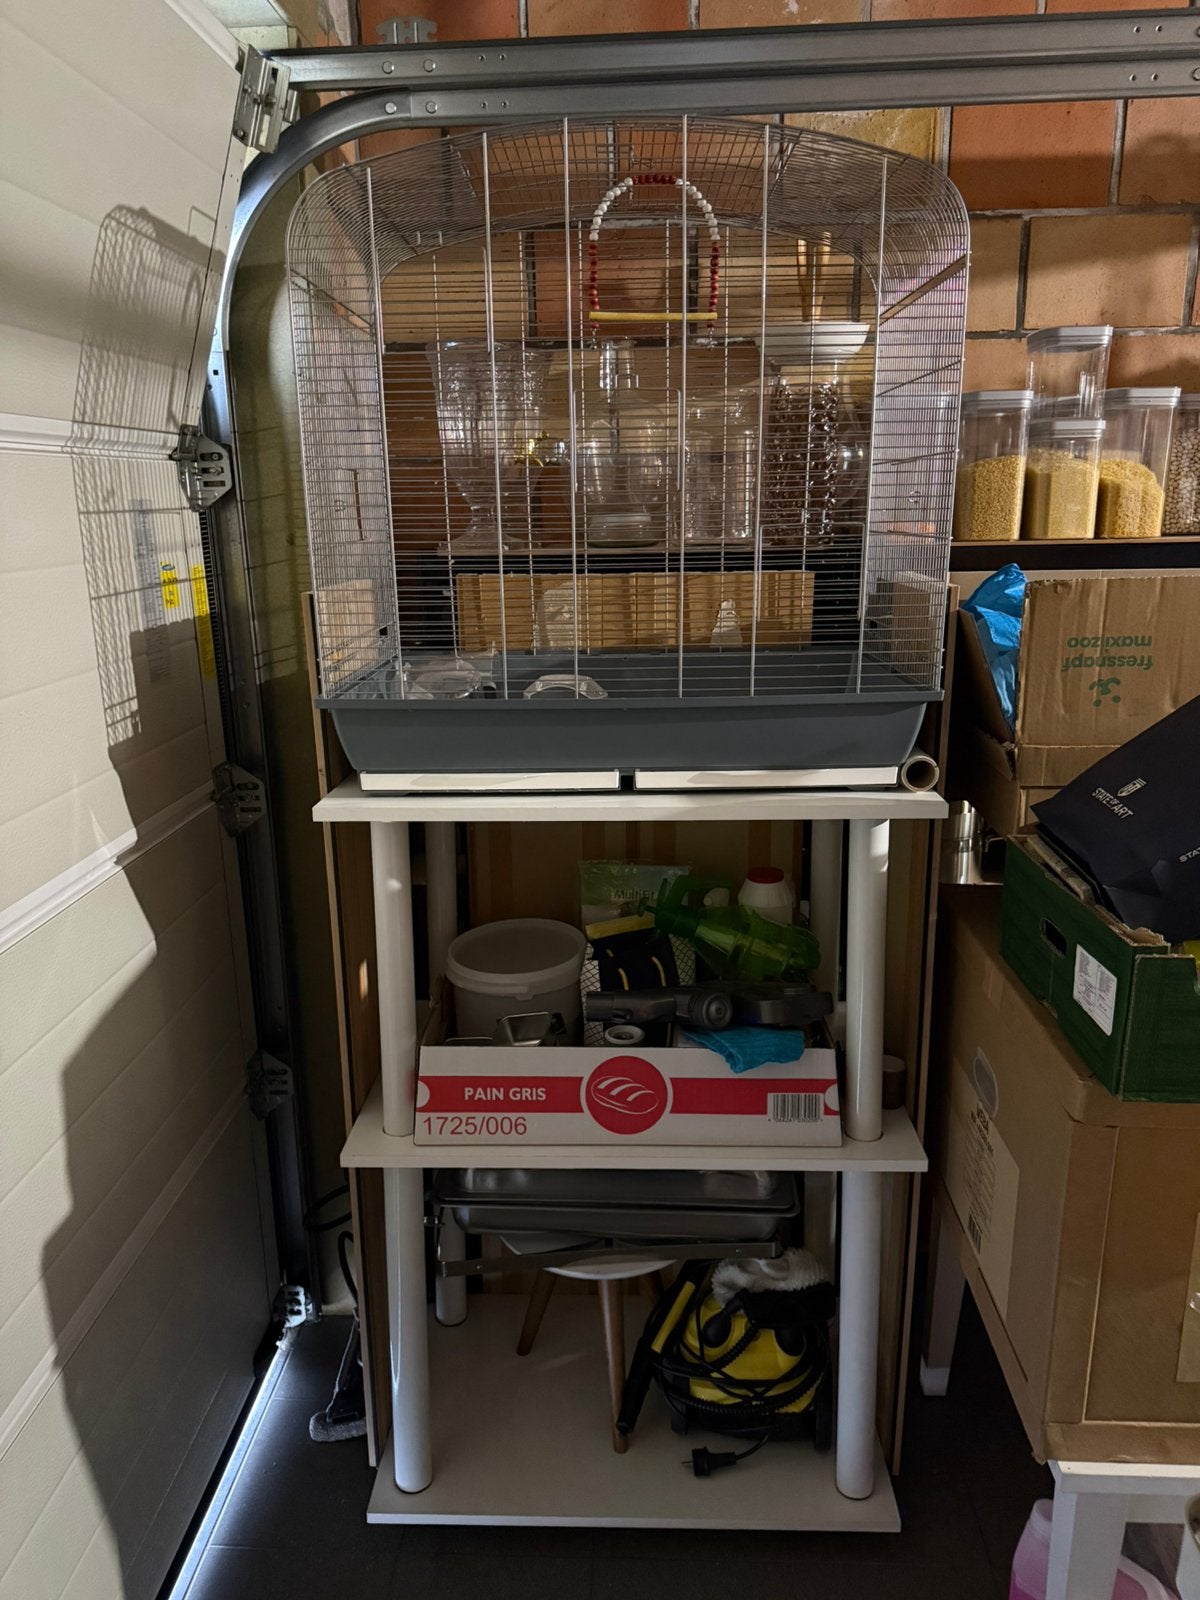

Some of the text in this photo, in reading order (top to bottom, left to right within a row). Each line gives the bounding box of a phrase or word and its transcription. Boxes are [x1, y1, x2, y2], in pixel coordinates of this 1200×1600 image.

[1067, 636, 1152, 653] maxi zoo
[1061, 653, 1153, 672] fressnapf
[1111, 804, 1134, 819] ART
[464, 1087, 546, 1101] PAIN GRIS
[423, 1116, 528, 1136] 1725/006
